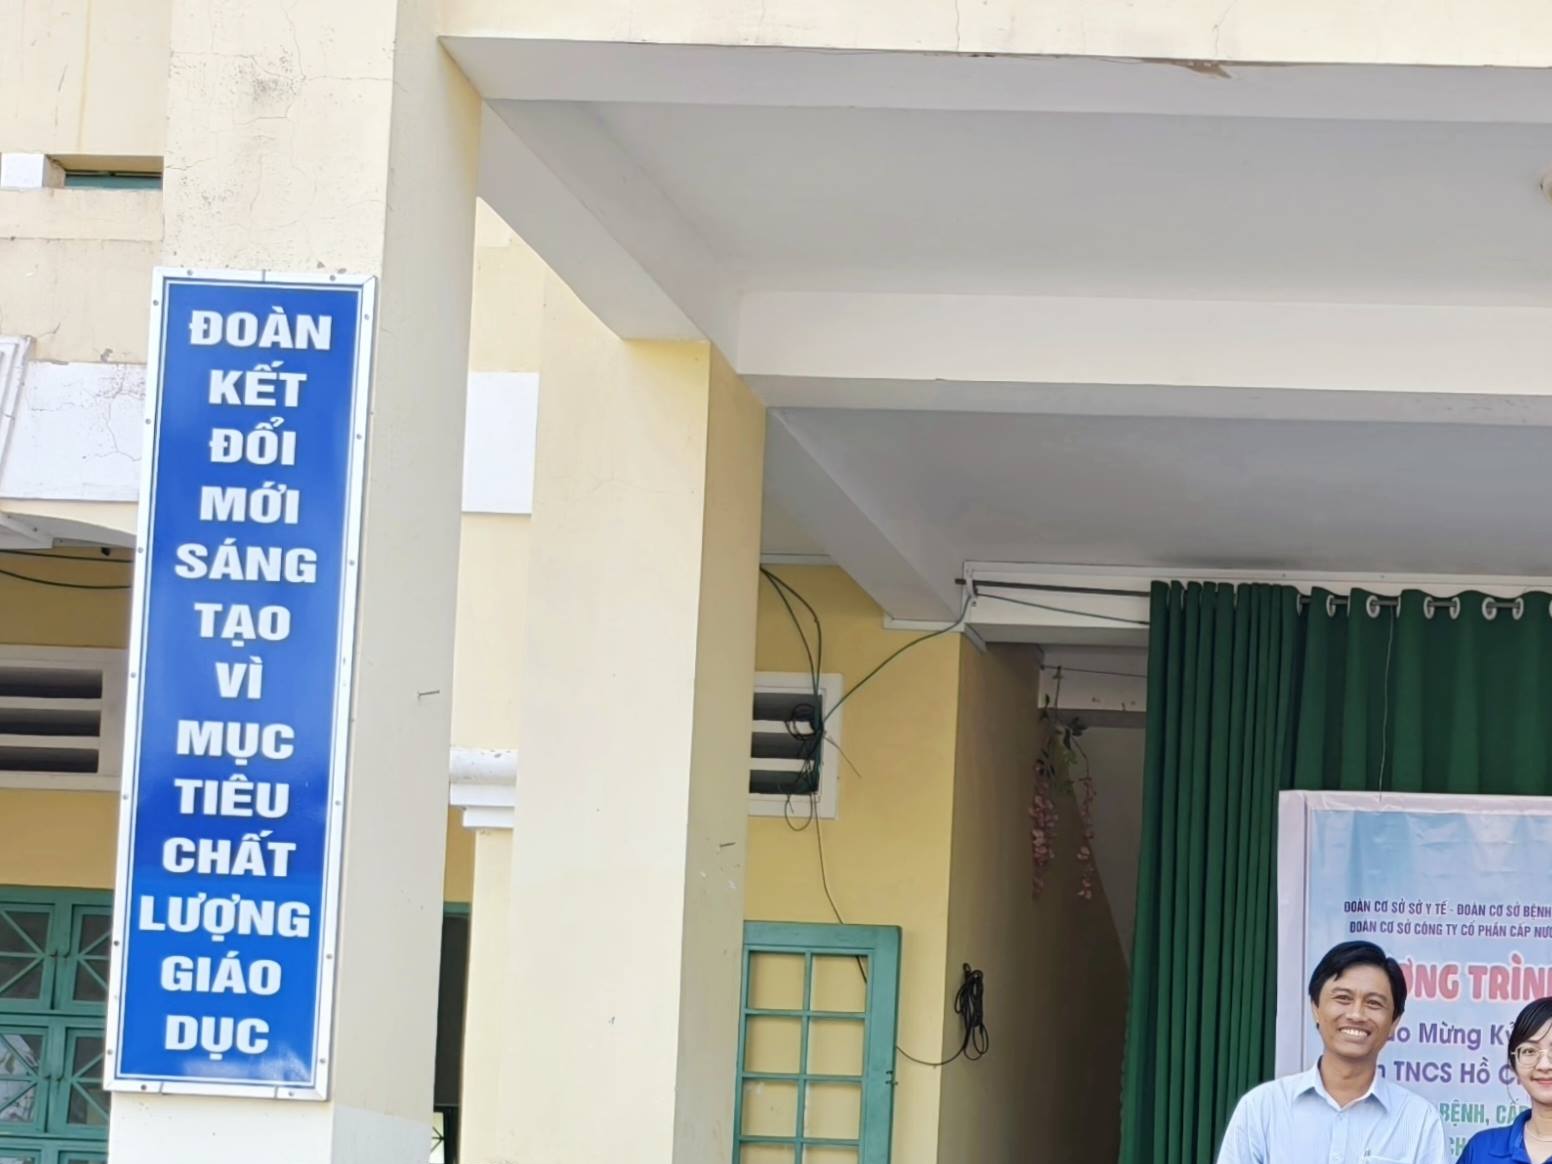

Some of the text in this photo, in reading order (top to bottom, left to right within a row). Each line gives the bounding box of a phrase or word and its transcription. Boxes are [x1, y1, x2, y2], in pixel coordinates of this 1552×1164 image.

[189, 306, 332, 350] ĐOÀN
[208, 360, 307, 407] KẾT
[209, 416, 296, 465] ĐỔI
[200, 481, 300, 524] MỚI
[175, 537, 317, 583] SÁNG
[194, 602, 291, 647] TẠO
[215, 655, 263, 699] VÌ
[176, 719, 295, 766] MỤC
[174, 773, 289, 818] TIÊU
[162, 830, 296, 877] CHẤT
[139, 892, 310, 942] LƯỢNG
[1344, 899, 1370, 912] ĐOÀN
[1375, 900, 1388, 913] CƠ
[1426, 904, 1432, 914] Y
[1435, 901, 1446, 915] TẾ
[1457, 903, 1485, 916] ĐOÀN
[1489, 903, 1503, 916] CƠ
[1350, 920, 1376, 933] ĐOÀN
[1380, 920, 1394, 933] CƠ
[1414, 921, 1442, 935] CÔNG
[1446, 924, 1457, 935] TY
[161, 951, 282, 995] GIÁO
[165, 1015, 269, 1060] DỤC
[1419, 1023, 1481, 1050] Mừng
[1393, 1060, 1452, 1083] TNCS
[1460, 1056, 1490, 1085] Hồ
